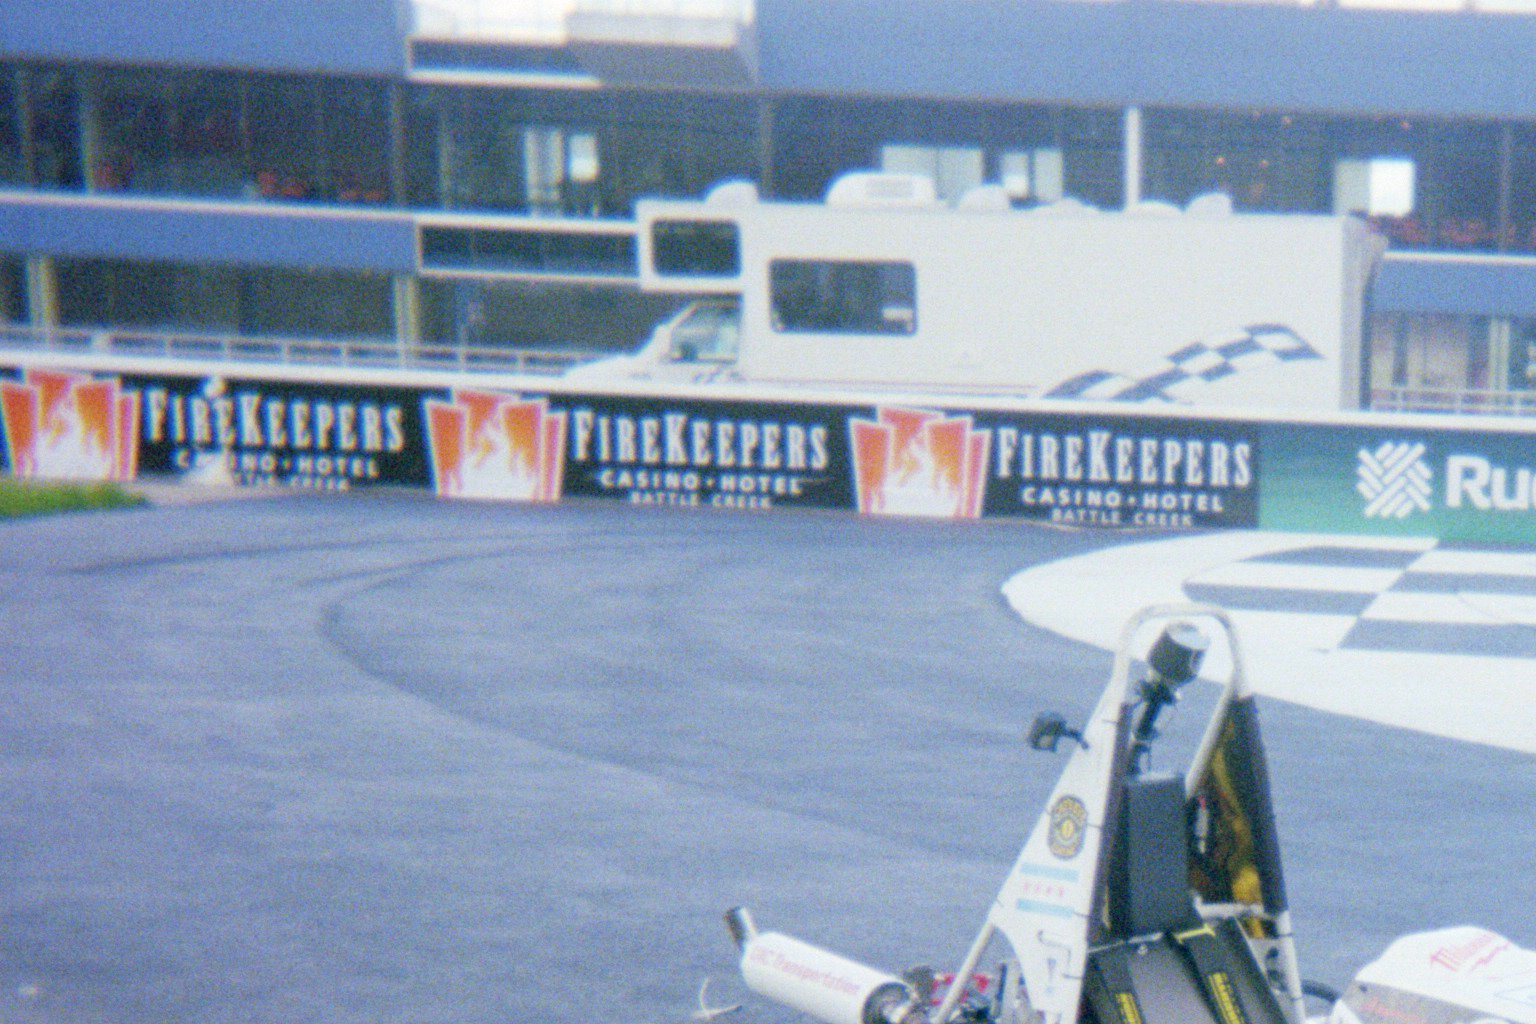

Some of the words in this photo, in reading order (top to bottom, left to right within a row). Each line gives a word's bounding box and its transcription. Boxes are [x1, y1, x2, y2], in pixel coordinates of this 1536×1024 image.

[175, 449, 278, 475] CINO
[298, 454, 380, 480] HOTEL
[600, 467, 699, 491] CASINO
[720, 473, 803, 496] HOTEL
[631, 490, 700, 506] BATTLE
[712, 494, 772, 510] CREEK
[1022, 486, 1122, 509] CASINO
[1142, 492, 1224, 514] HOTEL
[1052, 507, 1121, 525] BATTLE
[1134, 511, 1194, 528] CREEK
